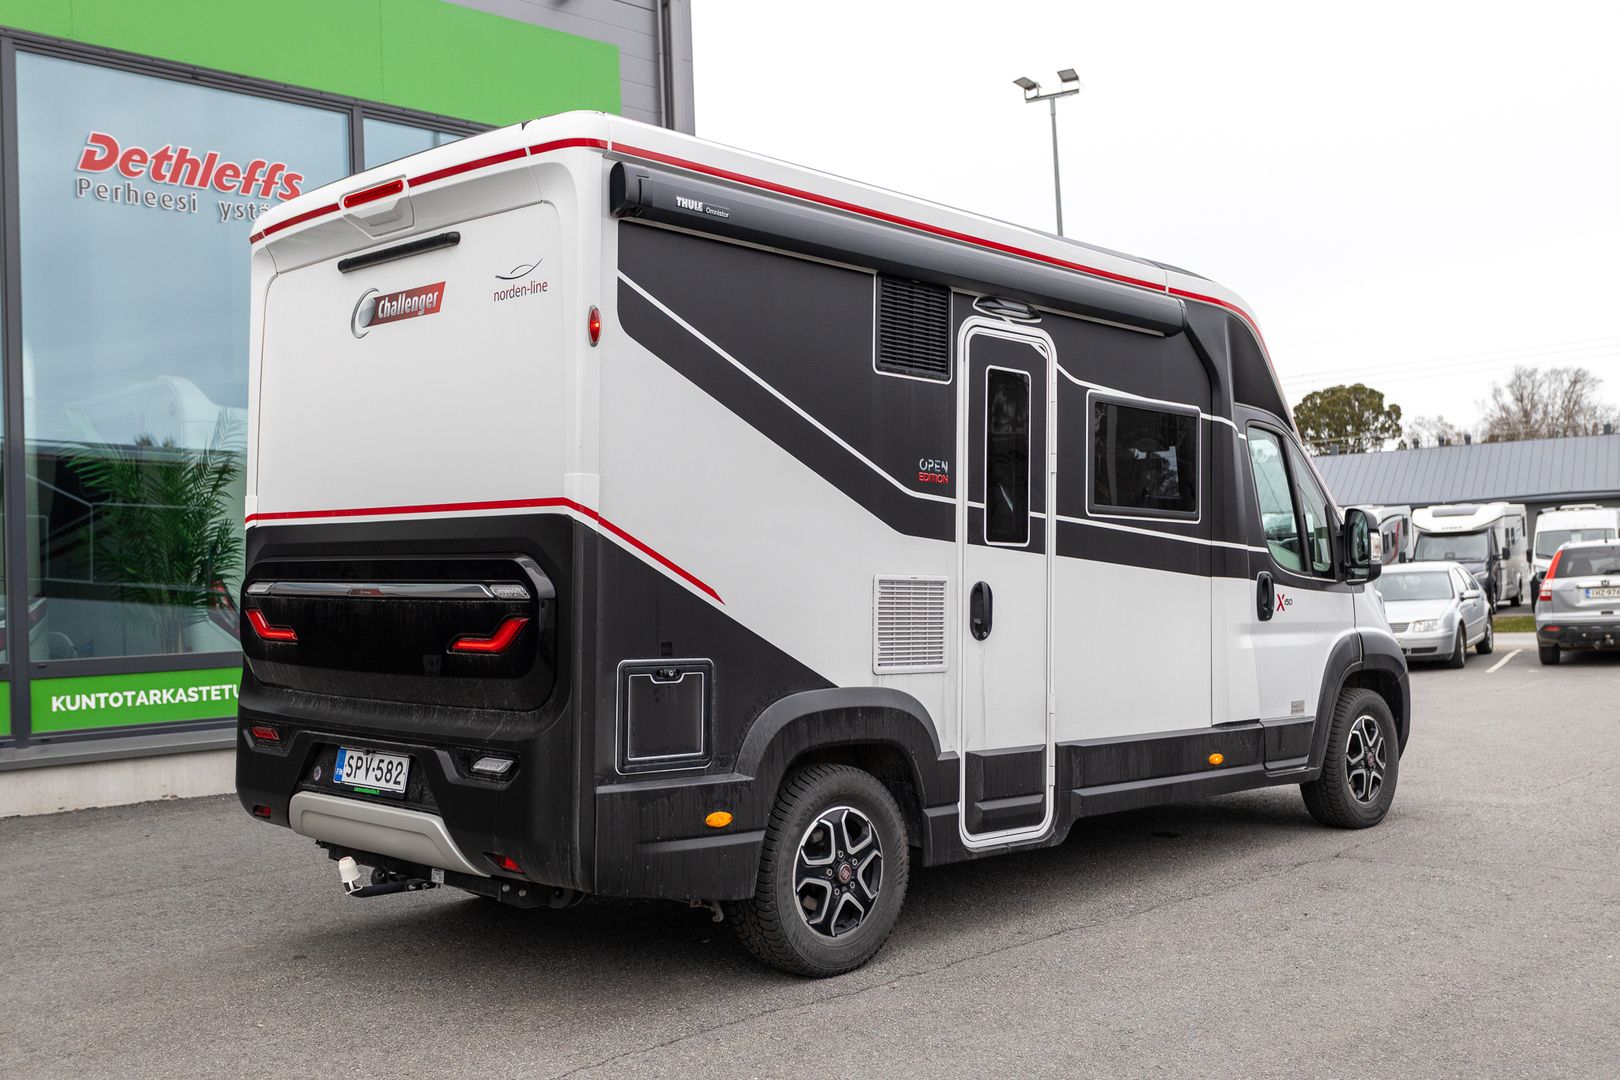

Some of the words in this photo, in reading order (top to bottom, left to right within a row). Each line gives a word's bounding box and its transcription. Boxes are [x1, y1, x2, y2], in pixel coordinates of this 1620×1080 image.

[78, 131, 304, 201] Dethleffs
[77, 178, 198, 212] Perheesi
[676, 196, 703, 212] THULE
[377, 289, 440, 319] Challenger
[493, 280, 549, 302] norden-line
[919, 458, 949, 473] OPEN
[918, 472, 949, 486] EDITION
[345, 755, 404, 786] SPV-582
